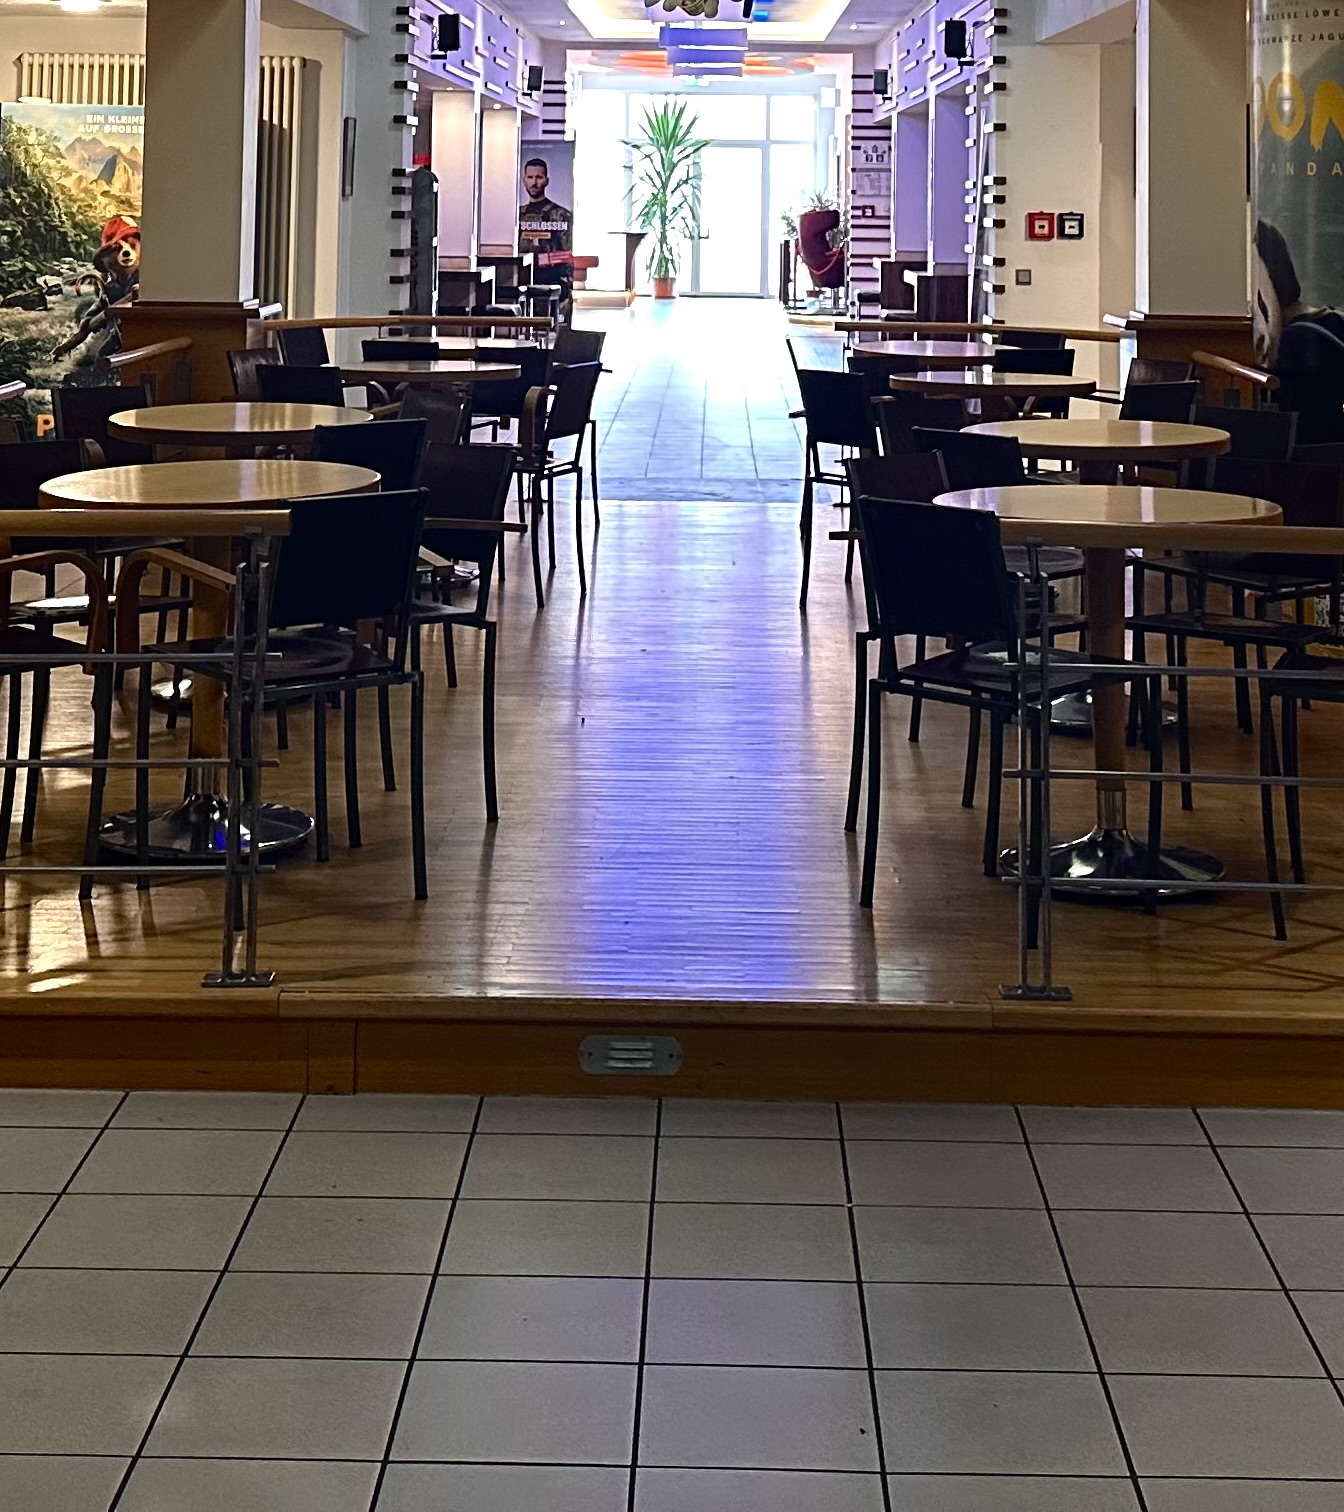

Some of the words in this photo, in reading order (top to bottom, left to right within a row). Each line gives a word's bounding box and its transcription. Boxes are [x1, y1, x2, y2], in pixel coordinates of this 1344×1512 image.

[1306, 8, 1341, 19] LÖWE
[86, 114, 105, 124] EIN
[78, 123, 100, 133] AUF
